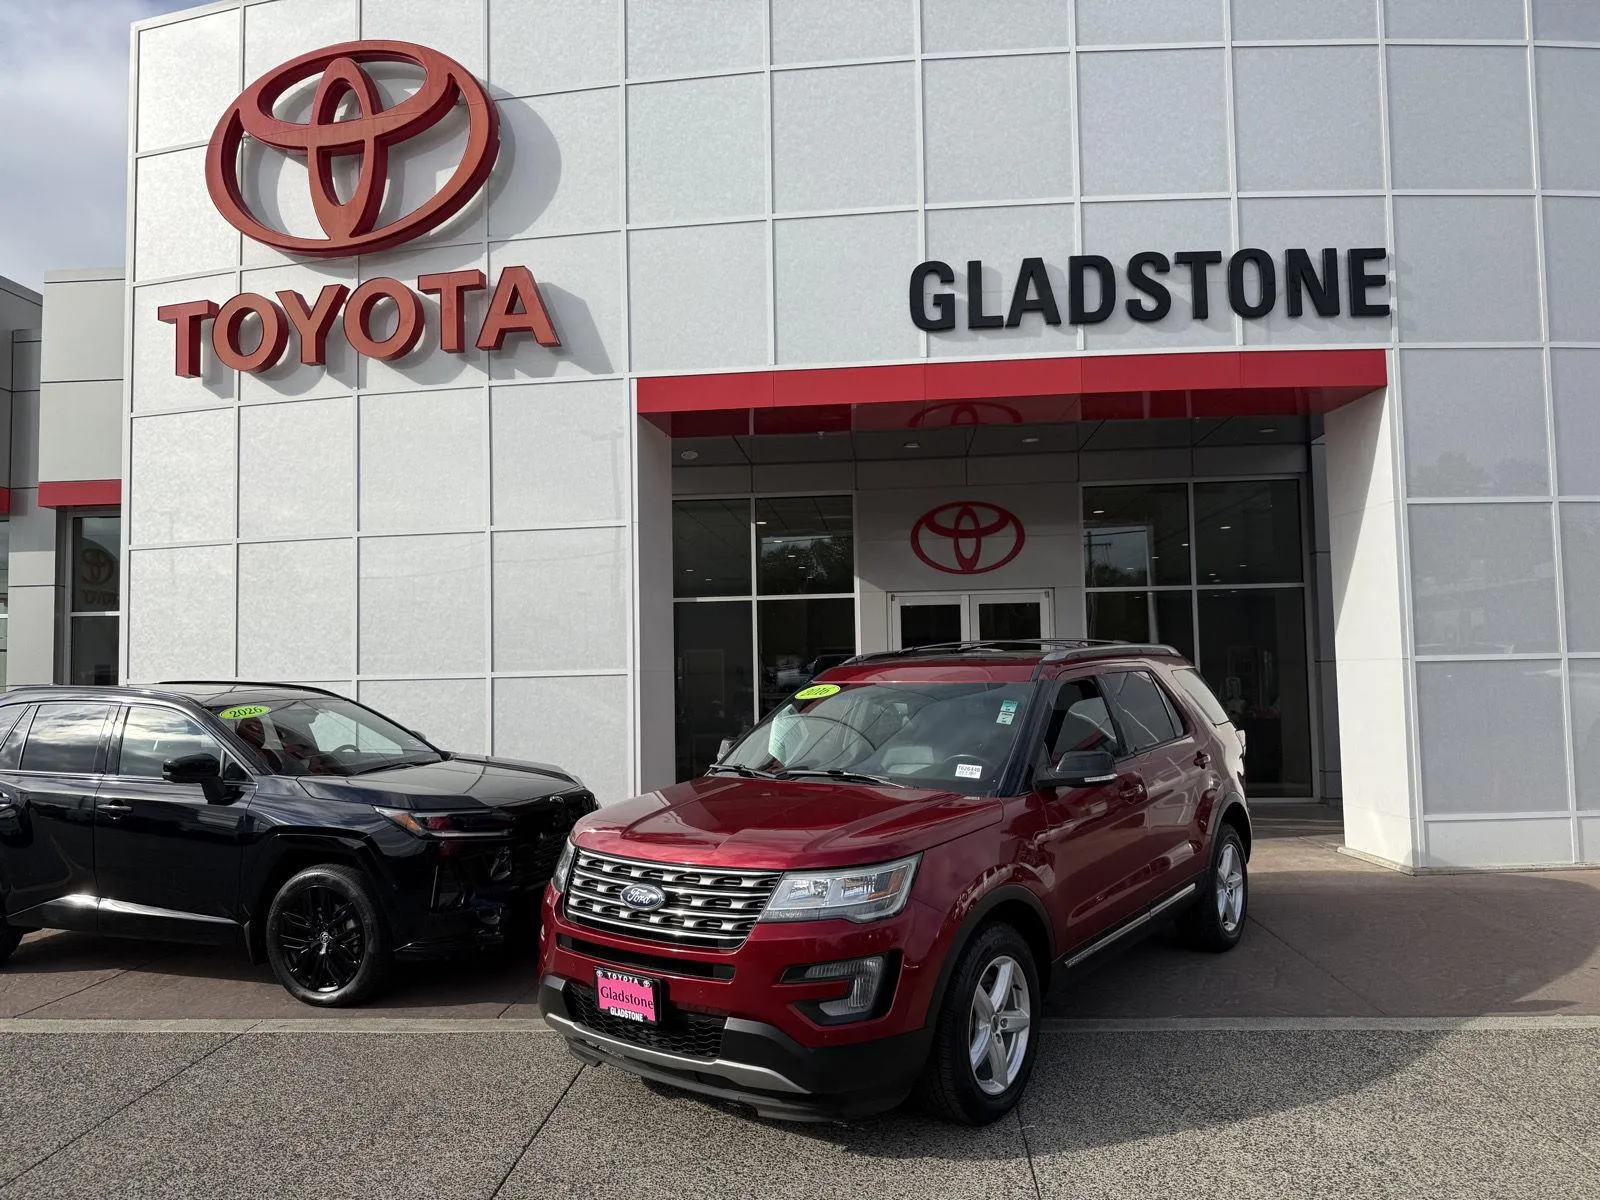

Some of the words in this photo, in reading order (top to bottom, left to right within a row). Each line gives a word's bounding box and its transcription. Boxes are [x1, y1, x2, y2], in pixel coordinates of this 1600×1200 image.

[909, 247, 1390, 332] GLADSTONE
[157, 265, 561, 379] TOYOTA
[229, 706, 262, 718] 2026
[627, 887, 650, 904] Ford
[607, 972, 638, 984] TOYOTA
[600, 986, 654, 1010] Gladstone
[610, 1006, 644, 1022] GLADSTONE
